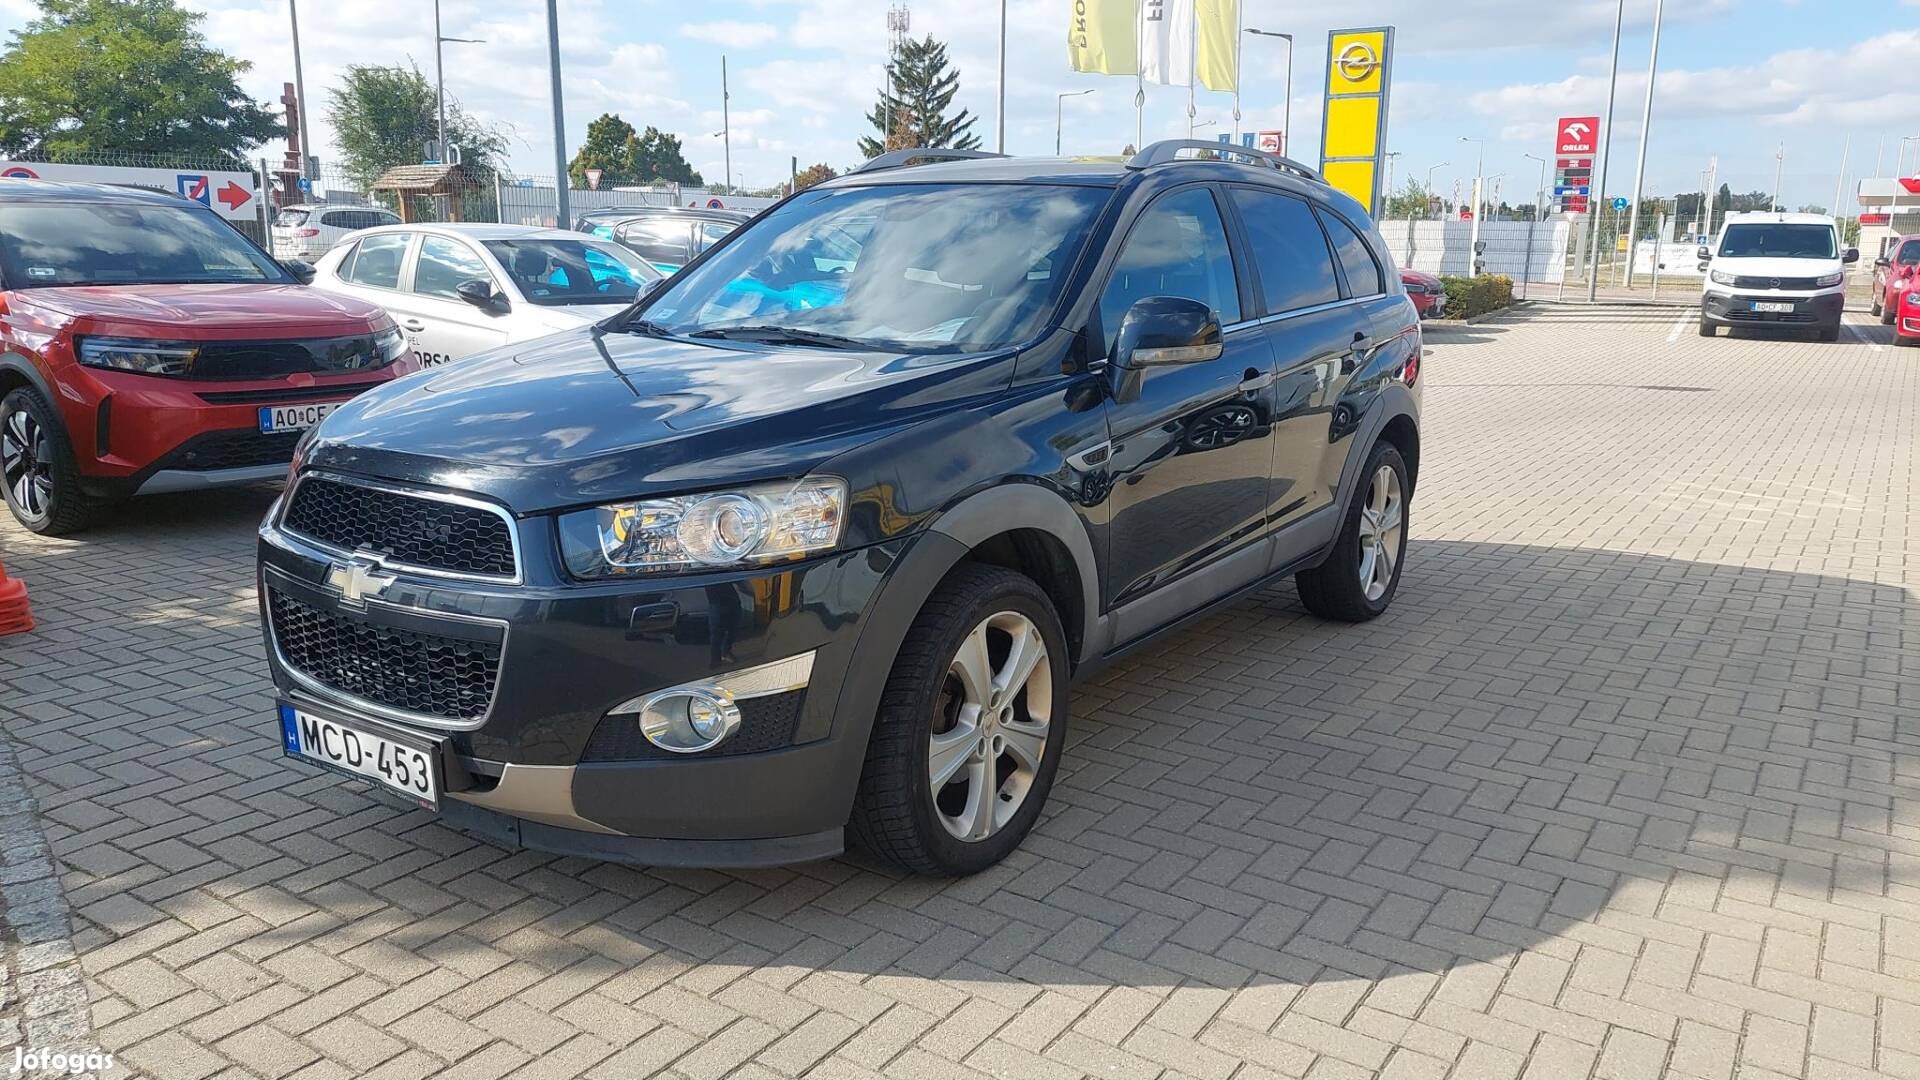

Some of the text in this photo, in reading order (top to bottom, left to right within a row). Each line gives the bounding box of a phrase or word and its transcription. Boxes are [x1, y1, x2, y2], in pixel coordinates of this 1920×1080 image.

[408, 336, 421, 346] PEL
[414, 351, 450, 369] ORSA
[276, 409, 297, 427] AO
[288, 731, 297, 746] H
[301, 716, 429, 793] MCD-453
